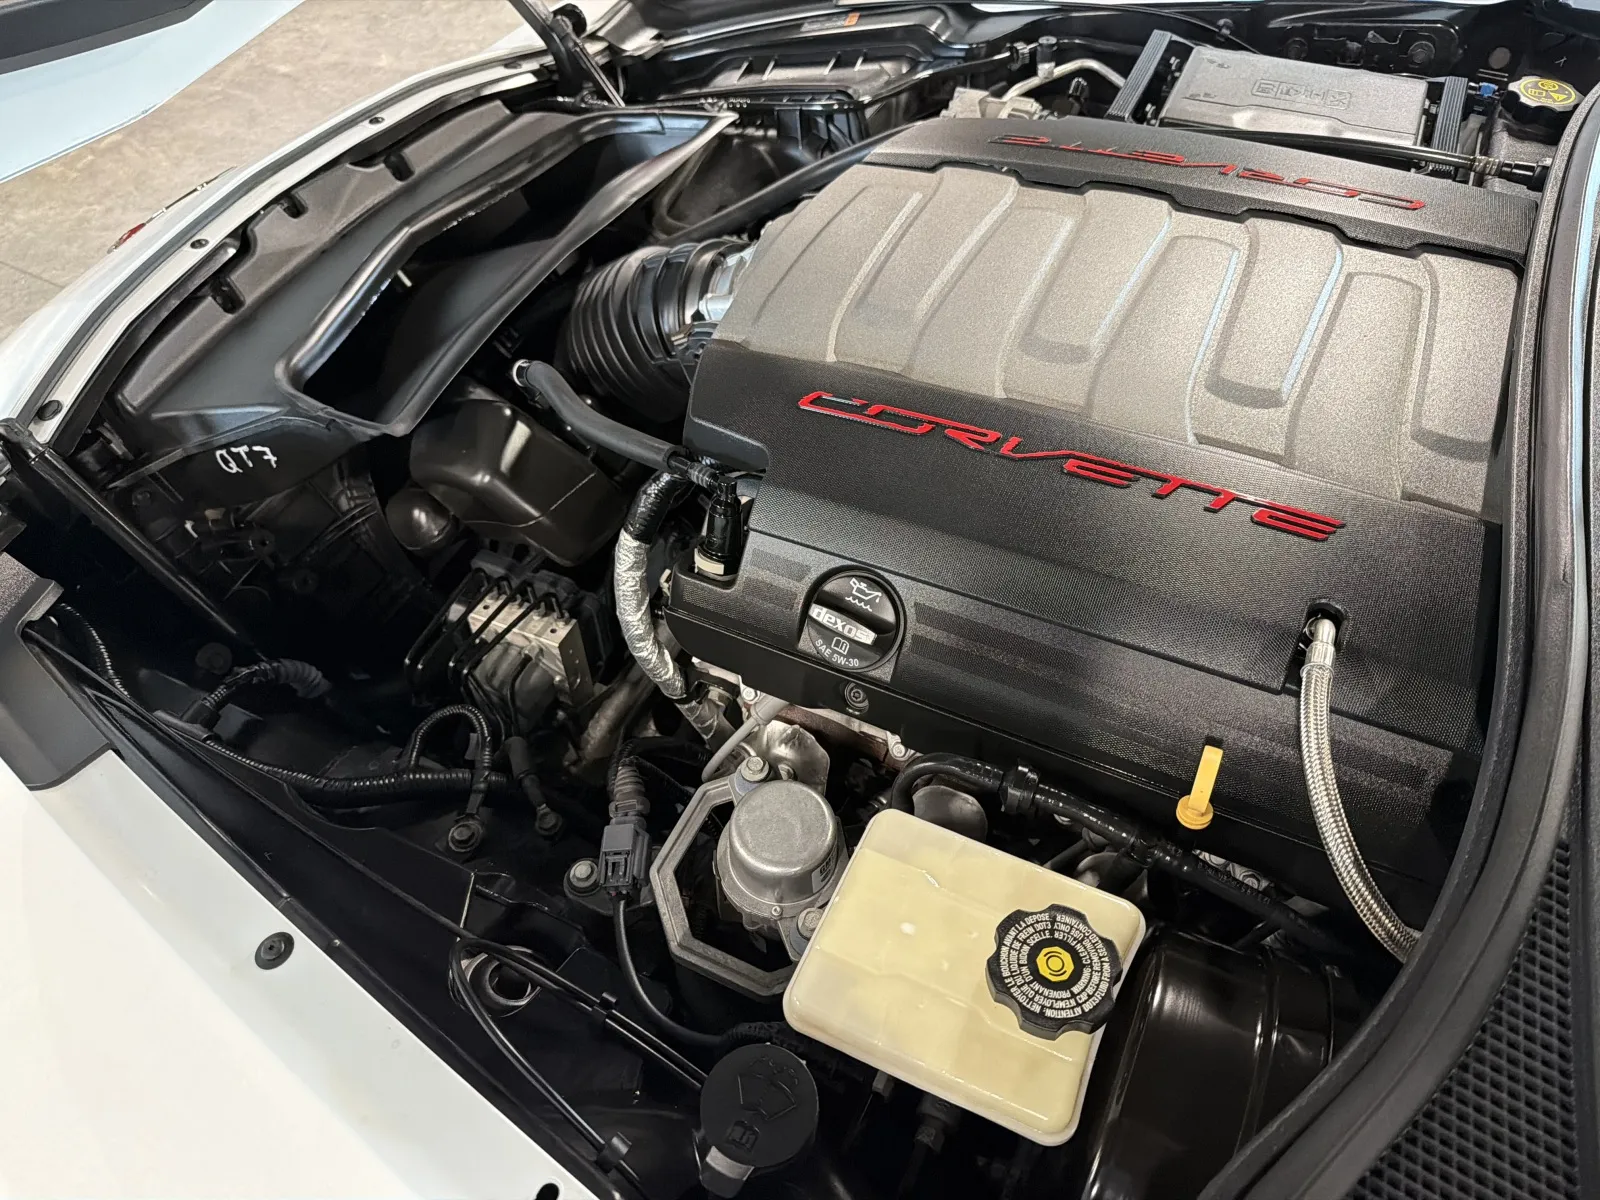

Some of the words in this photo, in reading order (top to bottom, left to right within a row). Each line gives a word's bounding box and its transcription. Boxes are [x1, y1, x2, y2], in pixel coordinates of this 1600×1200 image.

[988, 134, 1424, 210] CORVETTE
[215, 445, 278, 473] QT7
[798, 391, 1347, 541] CORVETTE
[815, 639, 832, 657] SAE
[832, 653, 859, 667] 5W-30
[1015, 921, 1026, 931] LA
[1017, 926, 1035, 941] FREIN
[1033, 922, 1051, 931] DOT3
[1054, 922, 1070, 932] ONLY
[1056, 914, 1091, 936] CONTAINER
[1070, 928, 1083, 940] USE
[1003, 927, 1019, 947] AVANT
[1011, 939, 1022, 950] DE
[1054, 930, 1078, 946] FILLER
[1089, 934, 1107, 956] SEALED
[1000, 945, 1011, 977] BOUCHON
[1009, 949, 1020, 975] LIQUIDE
[1019, 944, 1031, 964] BIDON
[1075, 943, 1091, 964] CLEAN
[1014, 975, 1024, 986] DU
[1101, 963, 1110, 981] FROM
[1004, 977, 1015, 987] LE
[1020, 984, 1035, 998] QUE
[1029, 981, 1071, 999] PROVENANT
[1086, 971, 1101, 995] BEFORE
[1094, 981, 1109, 1000] FLUID
[1010, 985, 1041, 1013] NETTOYER
[1076, 991, 1088, 1003] CAP
[1082, 996, 1099, 1012] DOT3
